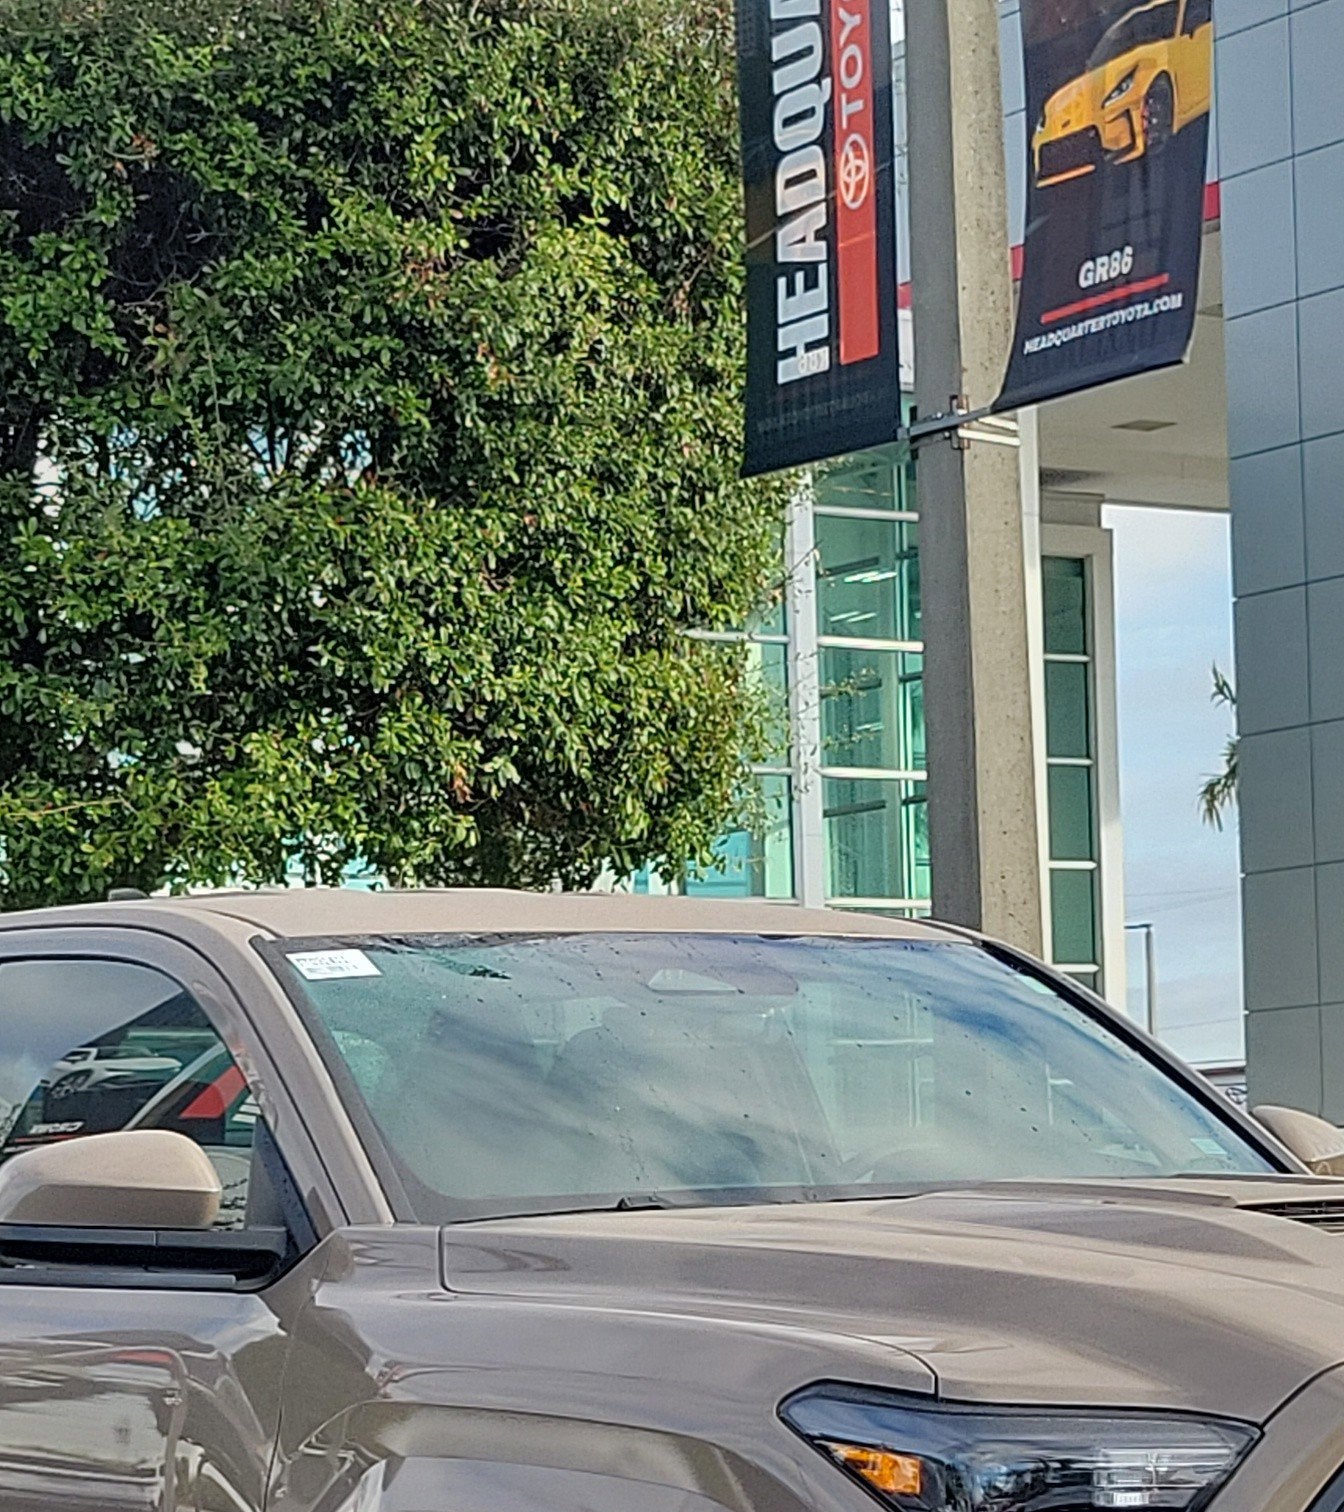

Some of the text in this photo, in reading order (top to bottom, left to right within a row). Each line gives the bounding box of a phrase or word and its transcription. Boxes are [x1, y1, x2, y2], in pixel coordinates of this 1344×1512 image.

[838, 0, 866, 127] TOY
[1078, 245, 1134, 289] GR86
[1023, 293, 1183, 356] HEADQUARTERTOYOTA.COM
